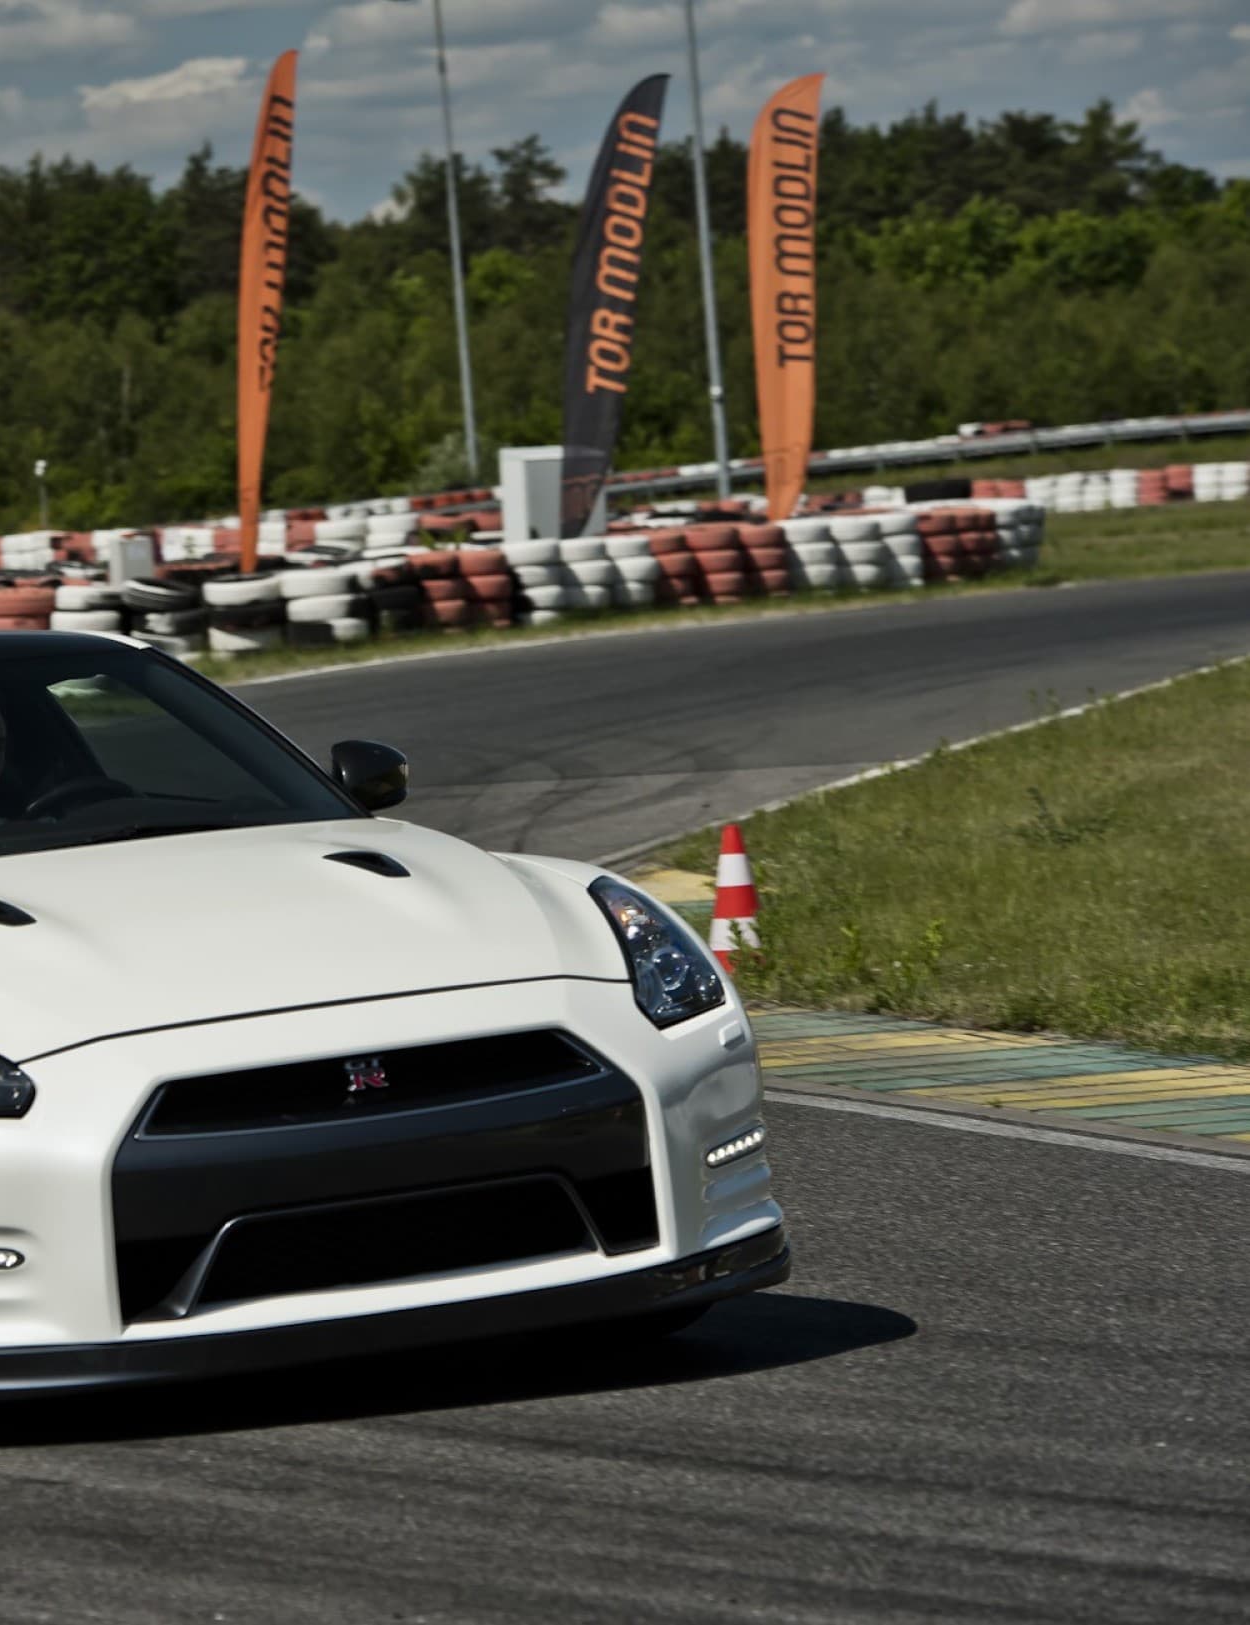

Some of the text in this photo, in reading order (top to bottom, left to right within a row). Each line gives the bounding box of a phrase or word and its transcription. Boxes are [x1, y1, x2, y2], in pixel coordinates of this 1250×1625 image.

[586, 110, 660, 394] TOR MODLIN
[771, 107, 815, 369] TOR MODLIN
